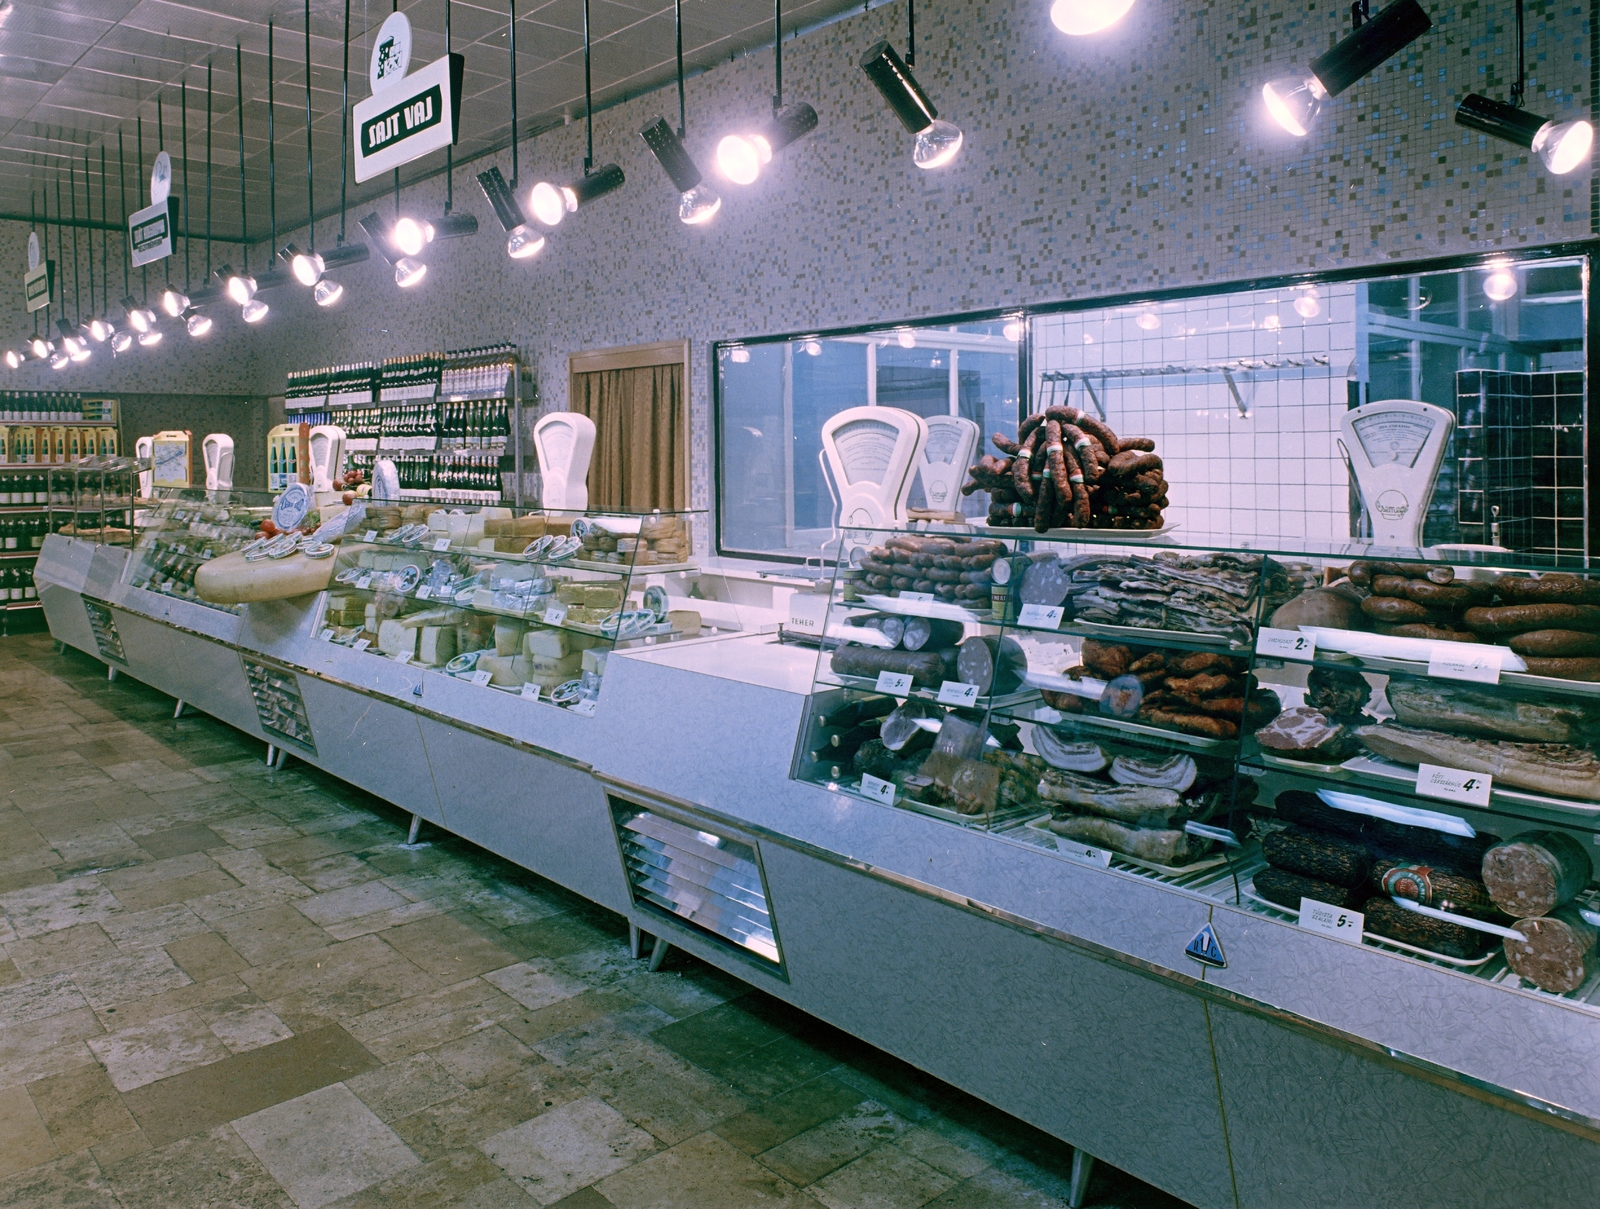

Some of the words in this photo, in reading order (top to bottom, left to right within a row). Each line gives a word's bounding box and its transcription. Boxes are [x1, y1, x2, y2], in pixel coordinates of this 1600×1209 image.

[368, 112, 400, 149] SAJT
[403, 95, 434, 130] VAJ
[791, 616, 815, 627] TEHER
